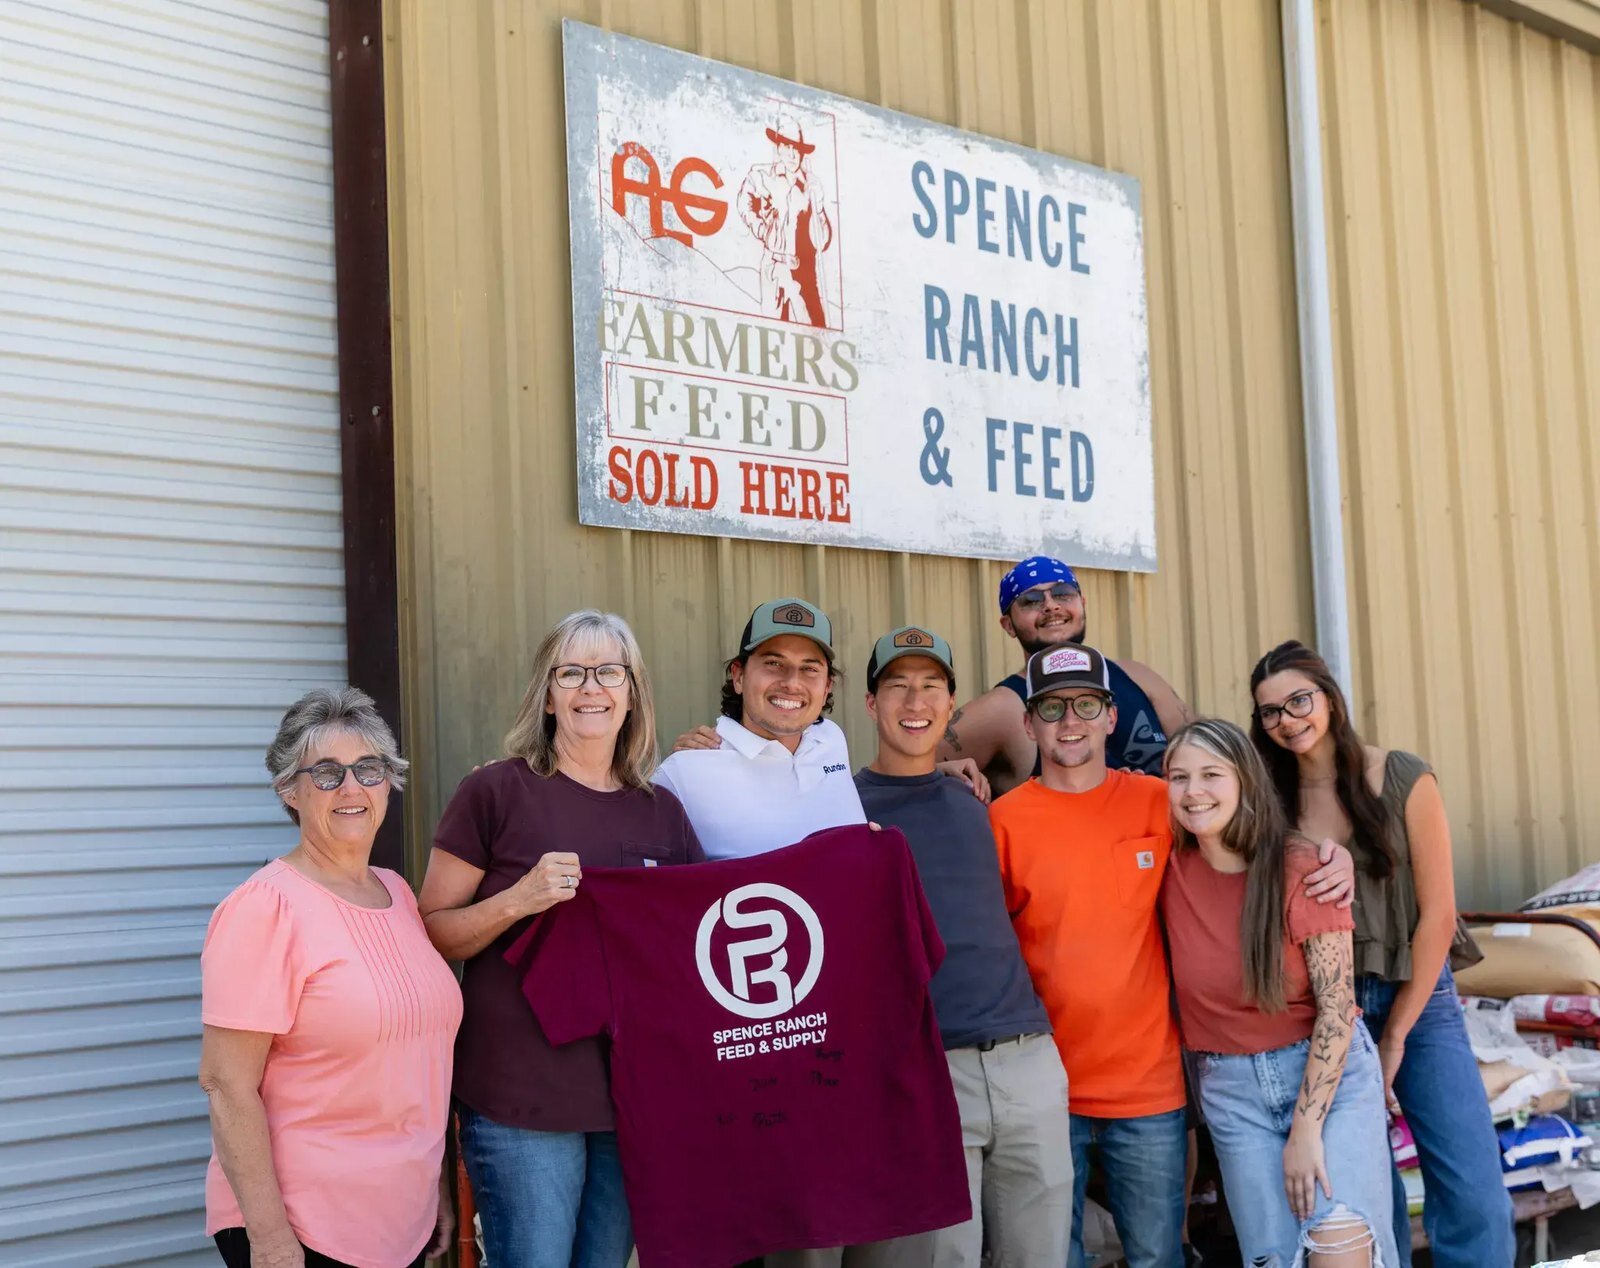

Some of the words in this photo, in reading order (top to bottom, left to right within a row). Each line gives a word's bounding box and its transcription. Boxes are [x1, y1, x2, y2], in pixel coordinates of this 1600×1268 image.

[911, 160, 1090, 275] SPENCE
[597, 298, 859, 393] FARMERS
[924, 283, 1080, 388] RANCH
[608, 445, 719, 511] SOLD
[739, 461, 851, 524] HERE
[919, 407, 953, 488] &
[986, 417, 1095, 503] FEED
[713, 1022, 773, 1044] SPENCE
[775, 1011, 827, 1033] RANCH
[716, 1043, 755, 1061] FEED
[758, 1040, 770, 1054] &
[772, 1029, 827, 1051] SUPPLY
